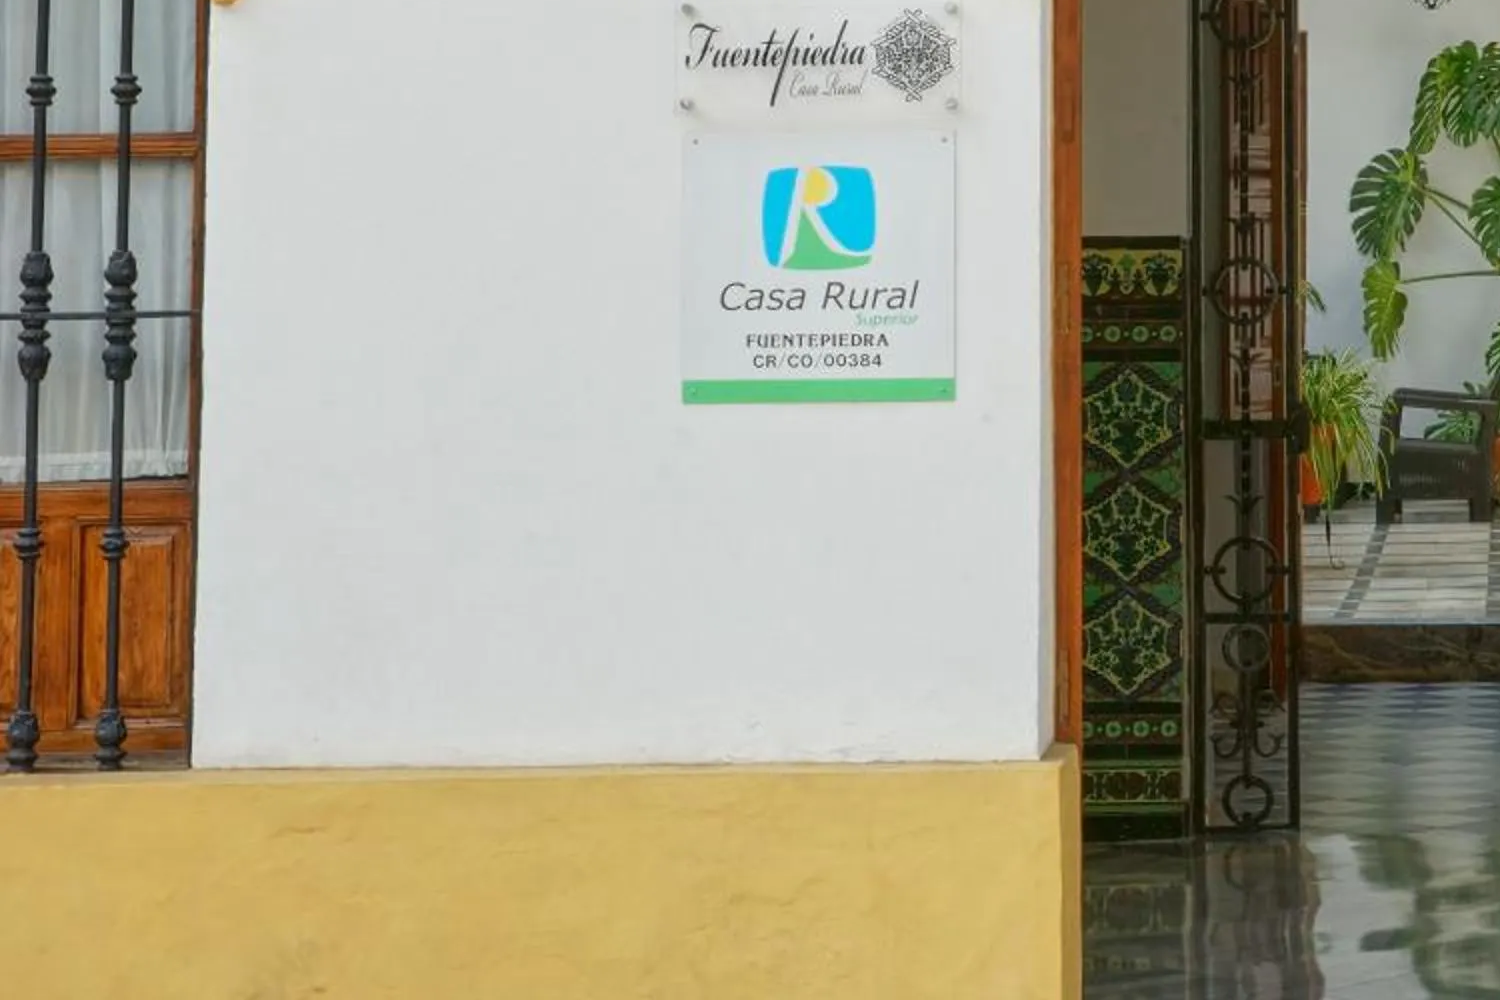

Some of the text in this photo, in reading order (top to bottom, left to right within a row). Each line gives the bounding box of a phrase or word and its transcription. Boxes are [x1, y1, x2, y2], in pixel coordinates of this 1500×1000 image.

[685, 19, 866, 107] Fuentepiedra
[720, 280, 919, 311] Casa Rural
[855, 313, 918, 327] Superior
[746, 333, 889, 348] FUENTEPIEDRA
